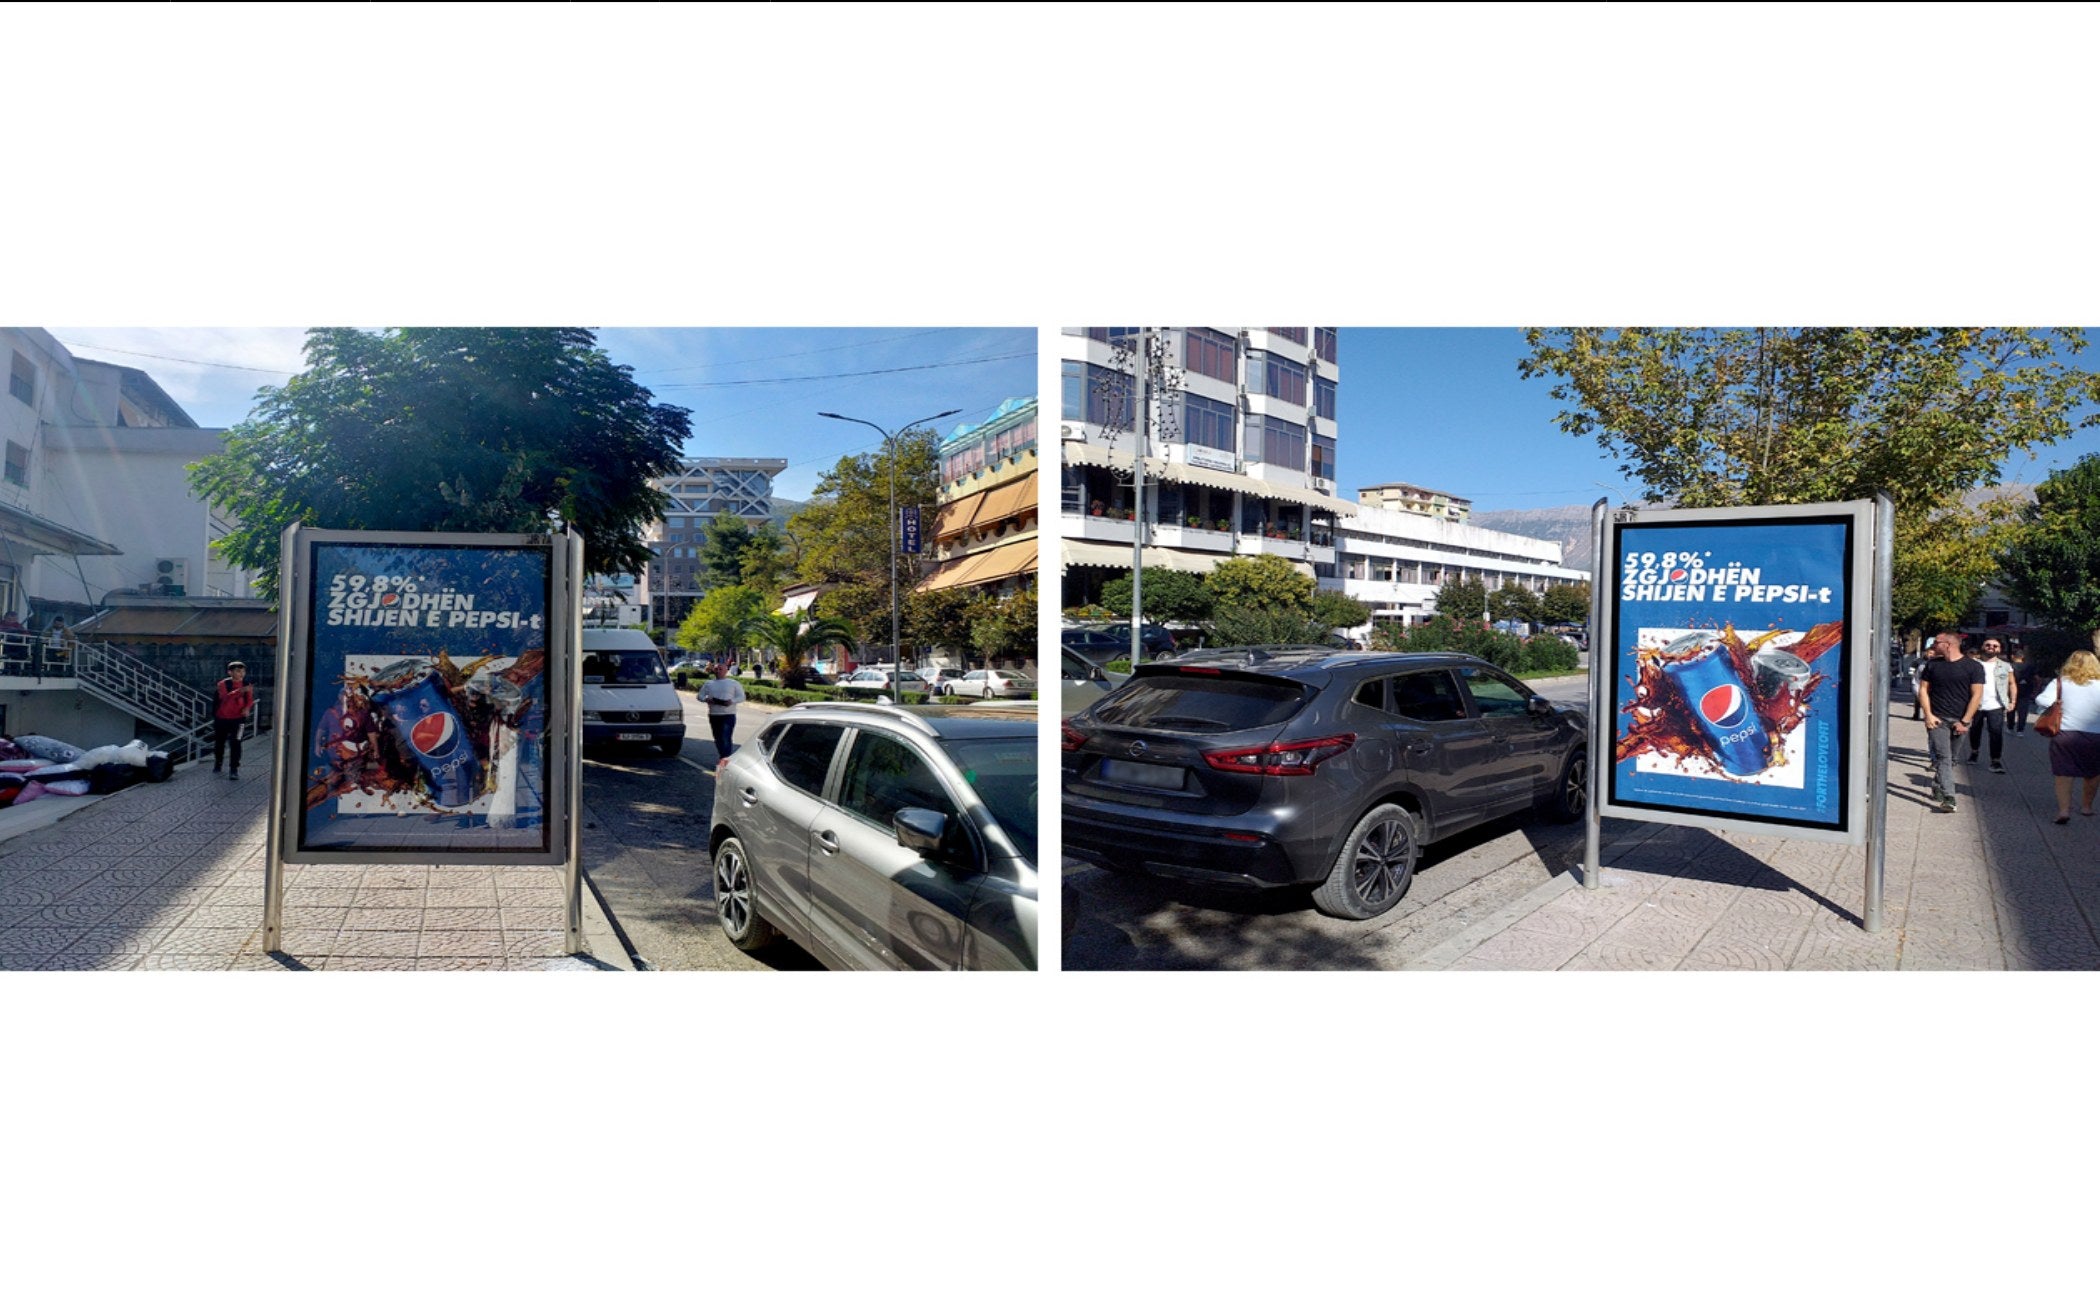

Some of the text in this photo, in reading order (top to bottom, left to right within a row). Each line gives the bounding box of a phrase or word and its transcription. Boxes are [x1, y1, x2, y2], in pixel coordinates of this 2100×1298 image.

[907, 519, 917, 552] HOTEL
[1621, 584, 1832, 604] SHIJEN E PEPSI-t
[327, 609, 542, 630] SHIJEN E PEPSI-t
[1720, 722, 1757, 747] pepsi
